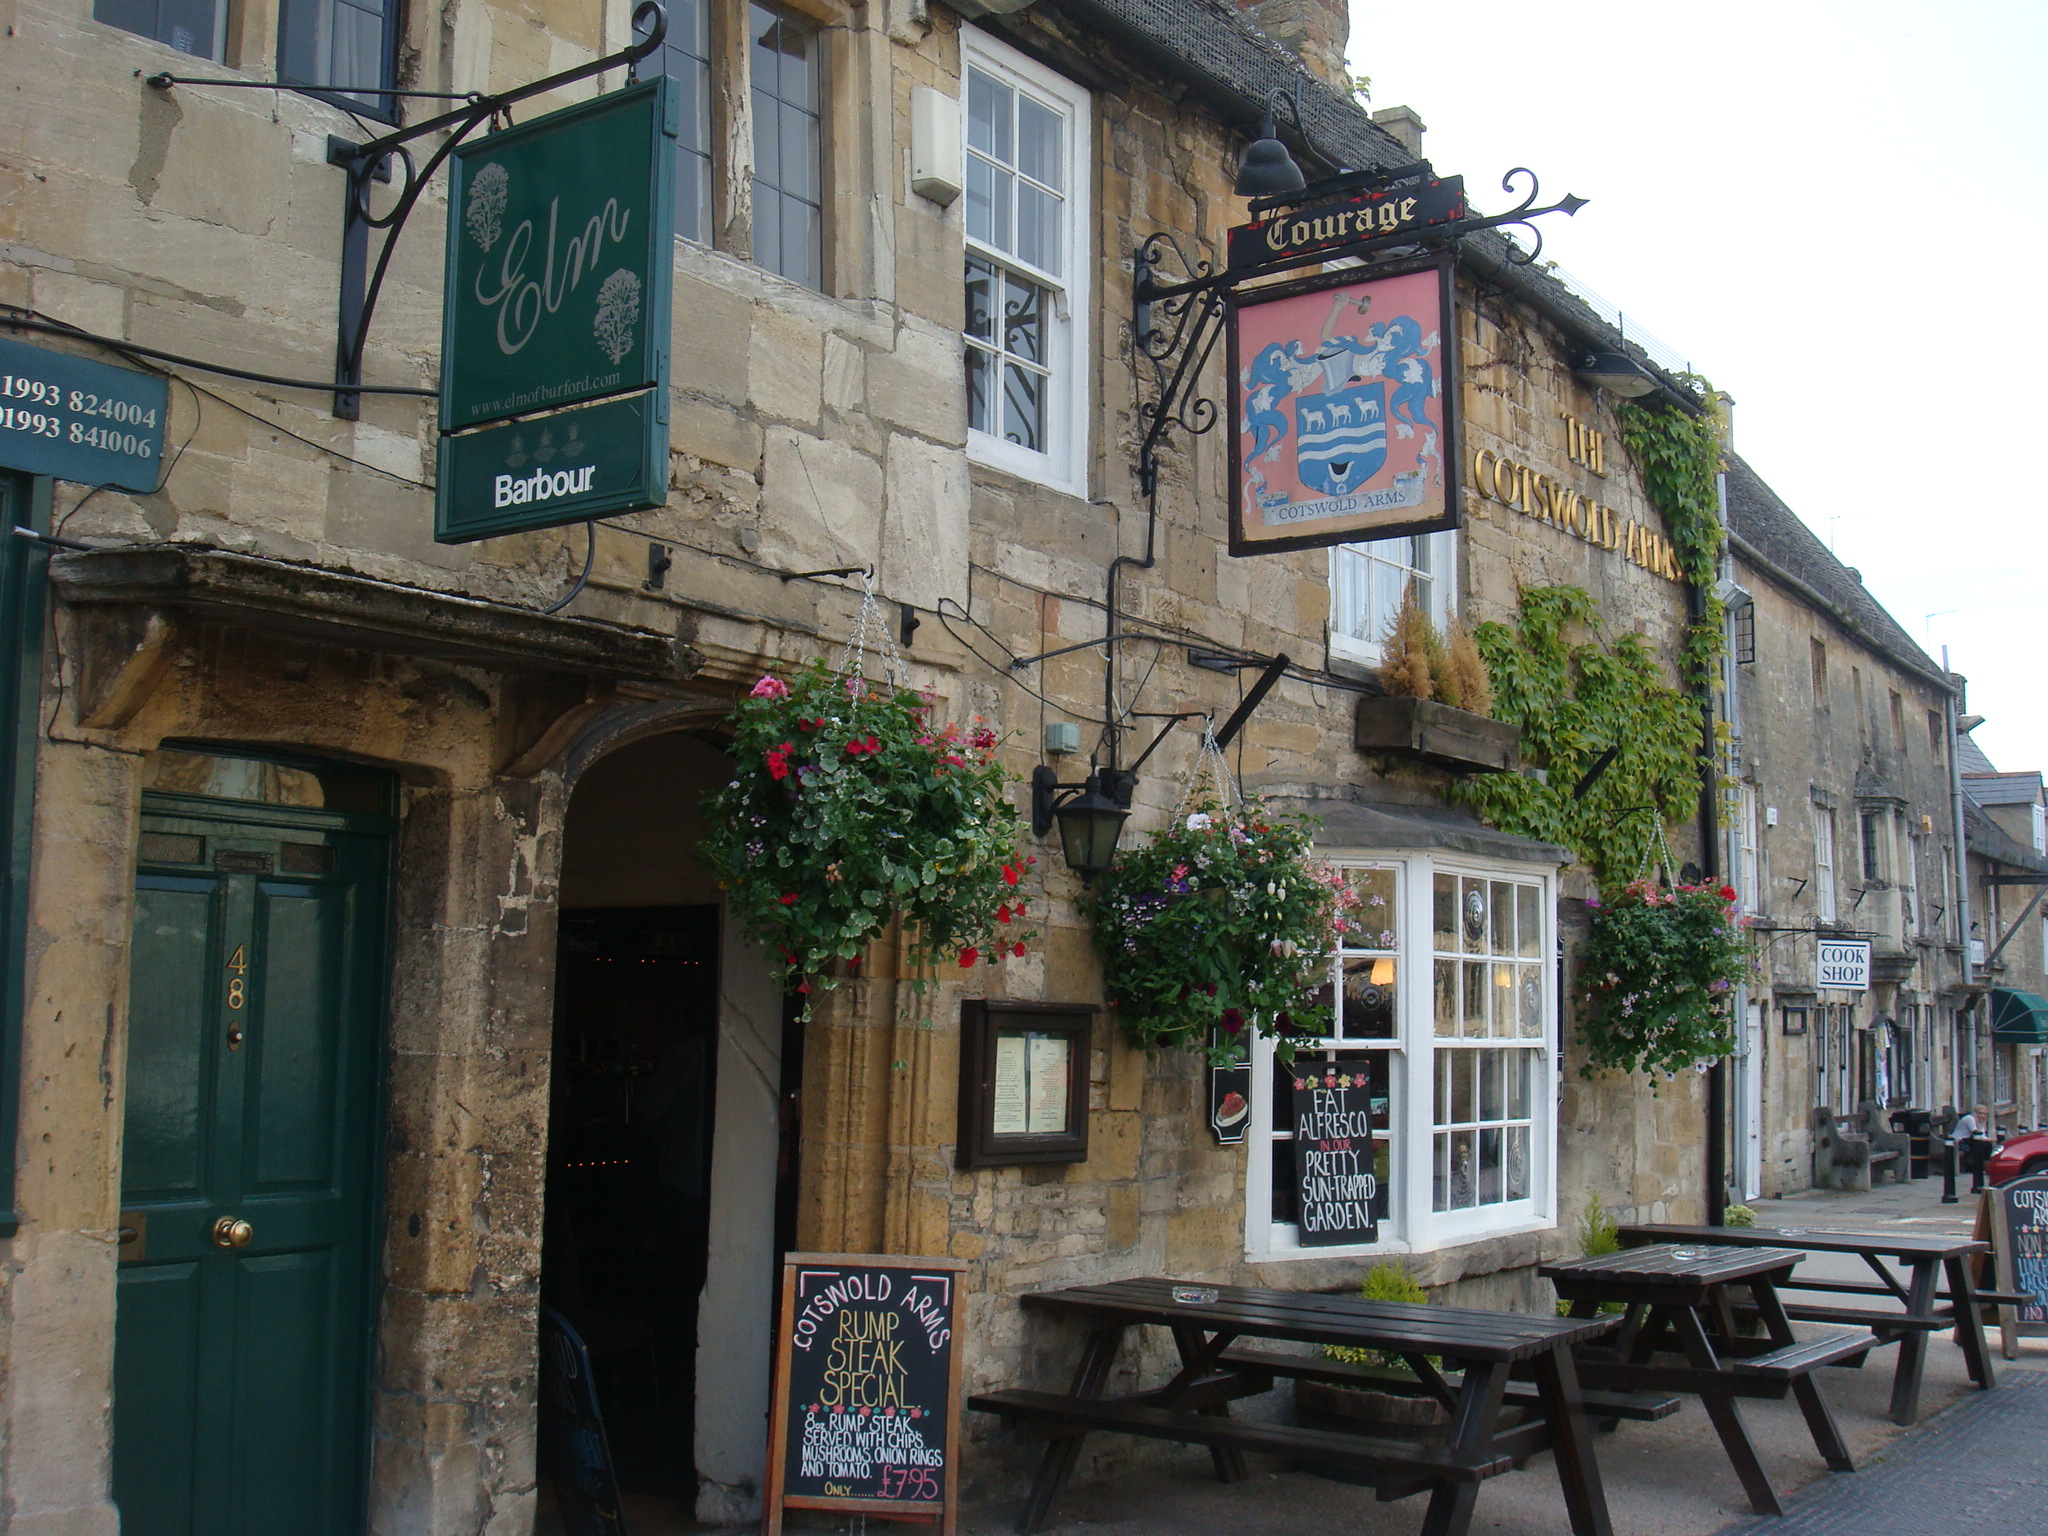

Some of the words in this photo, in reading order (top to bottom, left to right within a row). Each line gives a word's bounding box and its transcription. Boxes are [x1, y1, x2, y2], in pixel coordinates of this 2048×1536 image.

[1266, 196, 1418, 250] Courage
[475, 195, 631, 355] Elm
[69, 390, 156, 429] 824004
[471, 372, 620, 417] www.elmofburford.com
[69, 422, 152, 458] 841006
[1560, 412, 1608, 479] THE
[494, 465, 596, 508] Barbour
[1278, 494, 1357, 520] COTSWOLD
[1364, 491, 1406, 508] ARMS
[1475, 448, 1621, 551] COTSWOLD
[1624, 519, 1684, 581] ARMS
[1821, 947, 1865, 964] COOK
[1822, 965, 1864, 982] SHOP
[1314, 1087, 1349, 1115] EAT
[1299, 1111, 1368, 1141] ALFRESCO
[1319, 1139, 1331, 1151] IN
[1333, 1139, 1352, 1151] OUR
[1305, 1149, 1361, 1177] PRETTY
[1302, 1174, 1376, 1202] SUN-TRAPPED
[1303, 1201, 1374, 1232] GARDEN.
[794, 1274, 891, 1350] COTSWOLD
[839, 1309, 900, 1341] RUMP
[827, 1337, 908, 1376] STEAK
[804, 1411, 826, 1431] 8oz
[829, 1413, 866, 1433] RUMP
[803, 1430, 852, 1447] SERVED
[855, 1431, 885, 1448] WITH
[801, 1462, 824, 1478] AND
[827, 1462, 873, 1479] TOMATO.
[874, 1446, 907, 1465] ONION
[909, 1448, 944, 1467] RINGS
